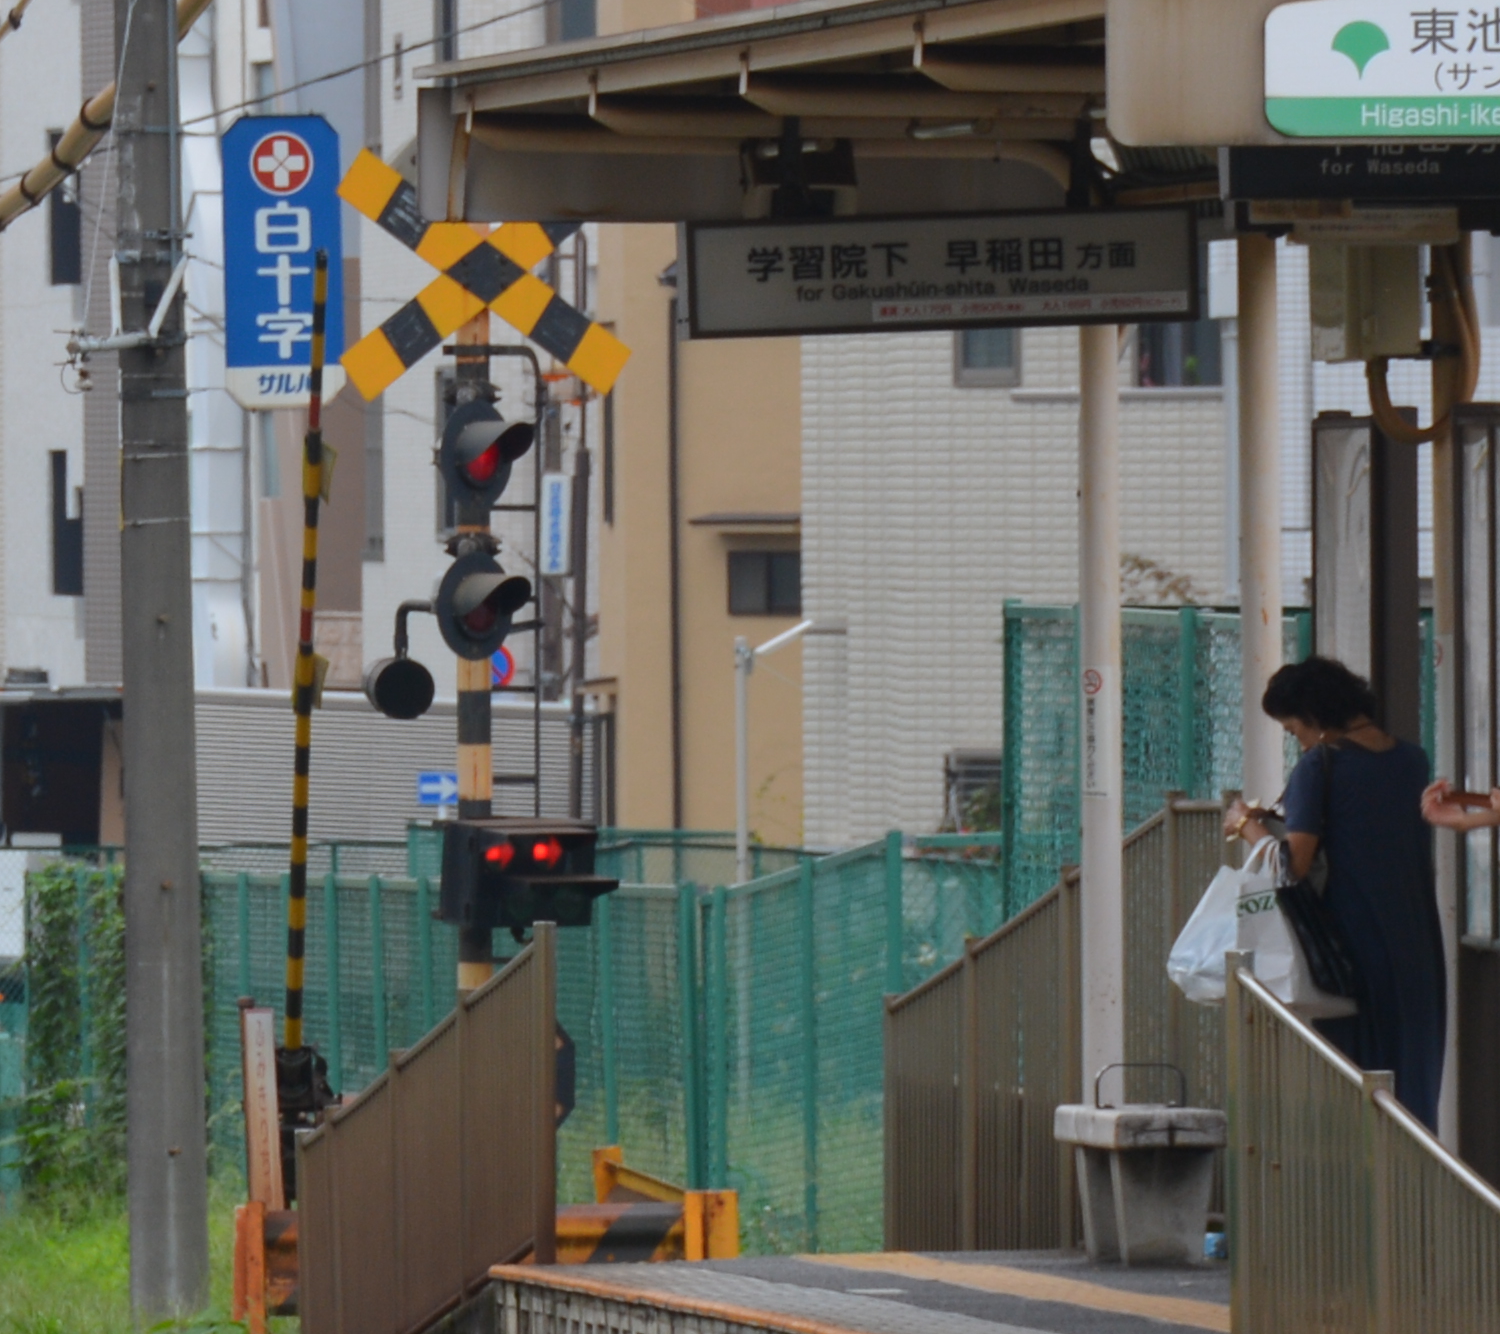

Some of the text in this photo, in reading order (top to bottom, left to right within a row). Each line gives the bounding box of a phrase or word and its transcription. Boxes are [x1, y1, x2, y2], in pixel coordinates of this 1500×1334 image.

[1321, 159, 1441, 175] for Waseda
[747, 237, 1136, 282] 学習院下 早稲田 方面
[255, 201, 313, 359] 白十字
[797, 284, 824, 303] for
[1009, 275, 1089, 296] Waseda
